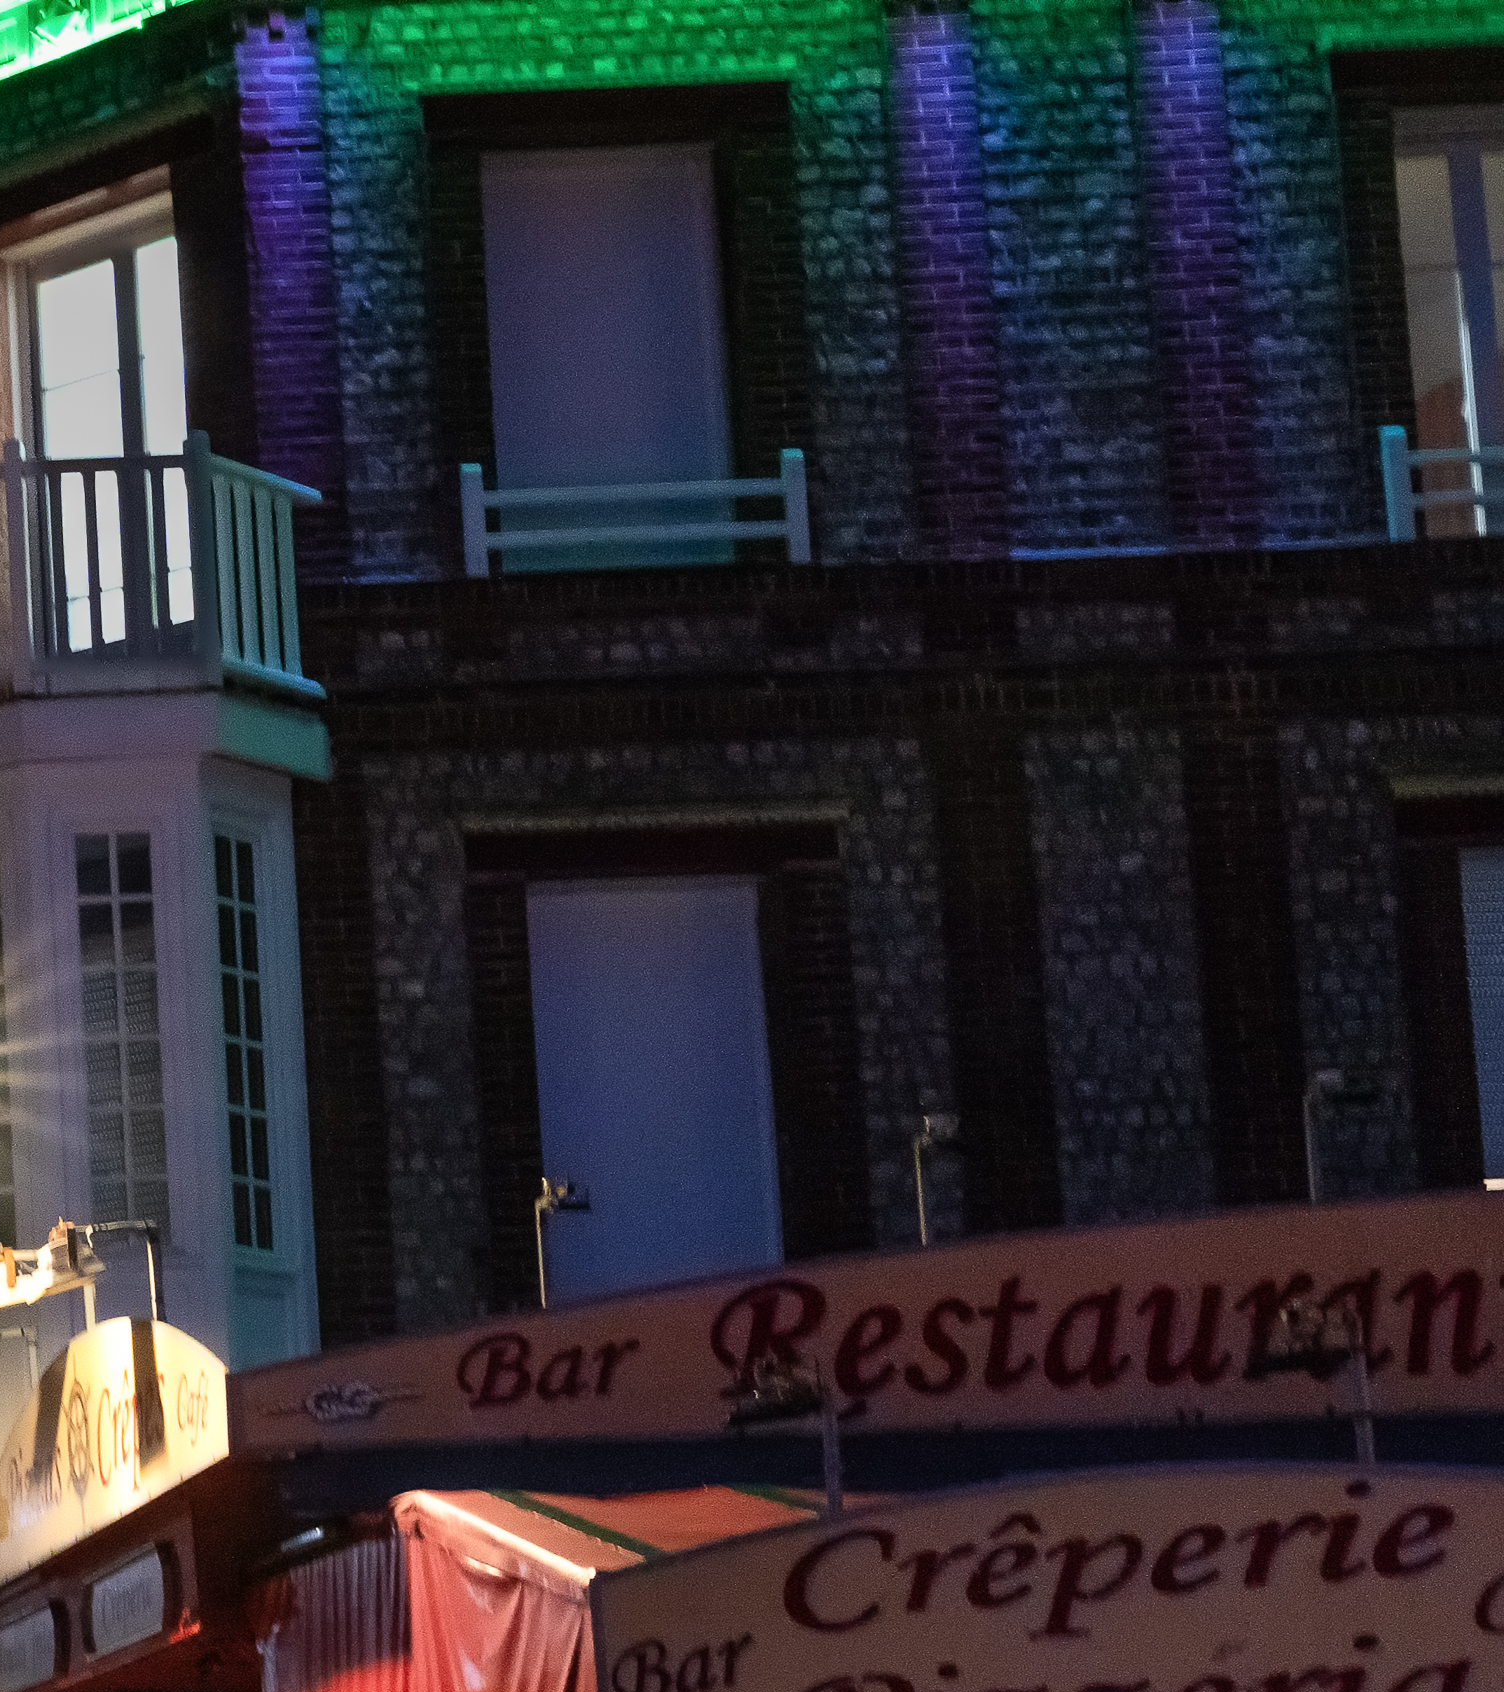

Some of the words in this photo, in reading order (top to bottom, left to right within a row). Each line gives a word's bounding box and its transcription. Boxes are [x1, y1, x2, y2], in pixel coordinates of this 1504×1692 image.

[457, 1332, 640, 1409] Bar
[711, 1268, 1504, 1420] Restauran
[784, 1480, 1455, 1638] Crêperie
